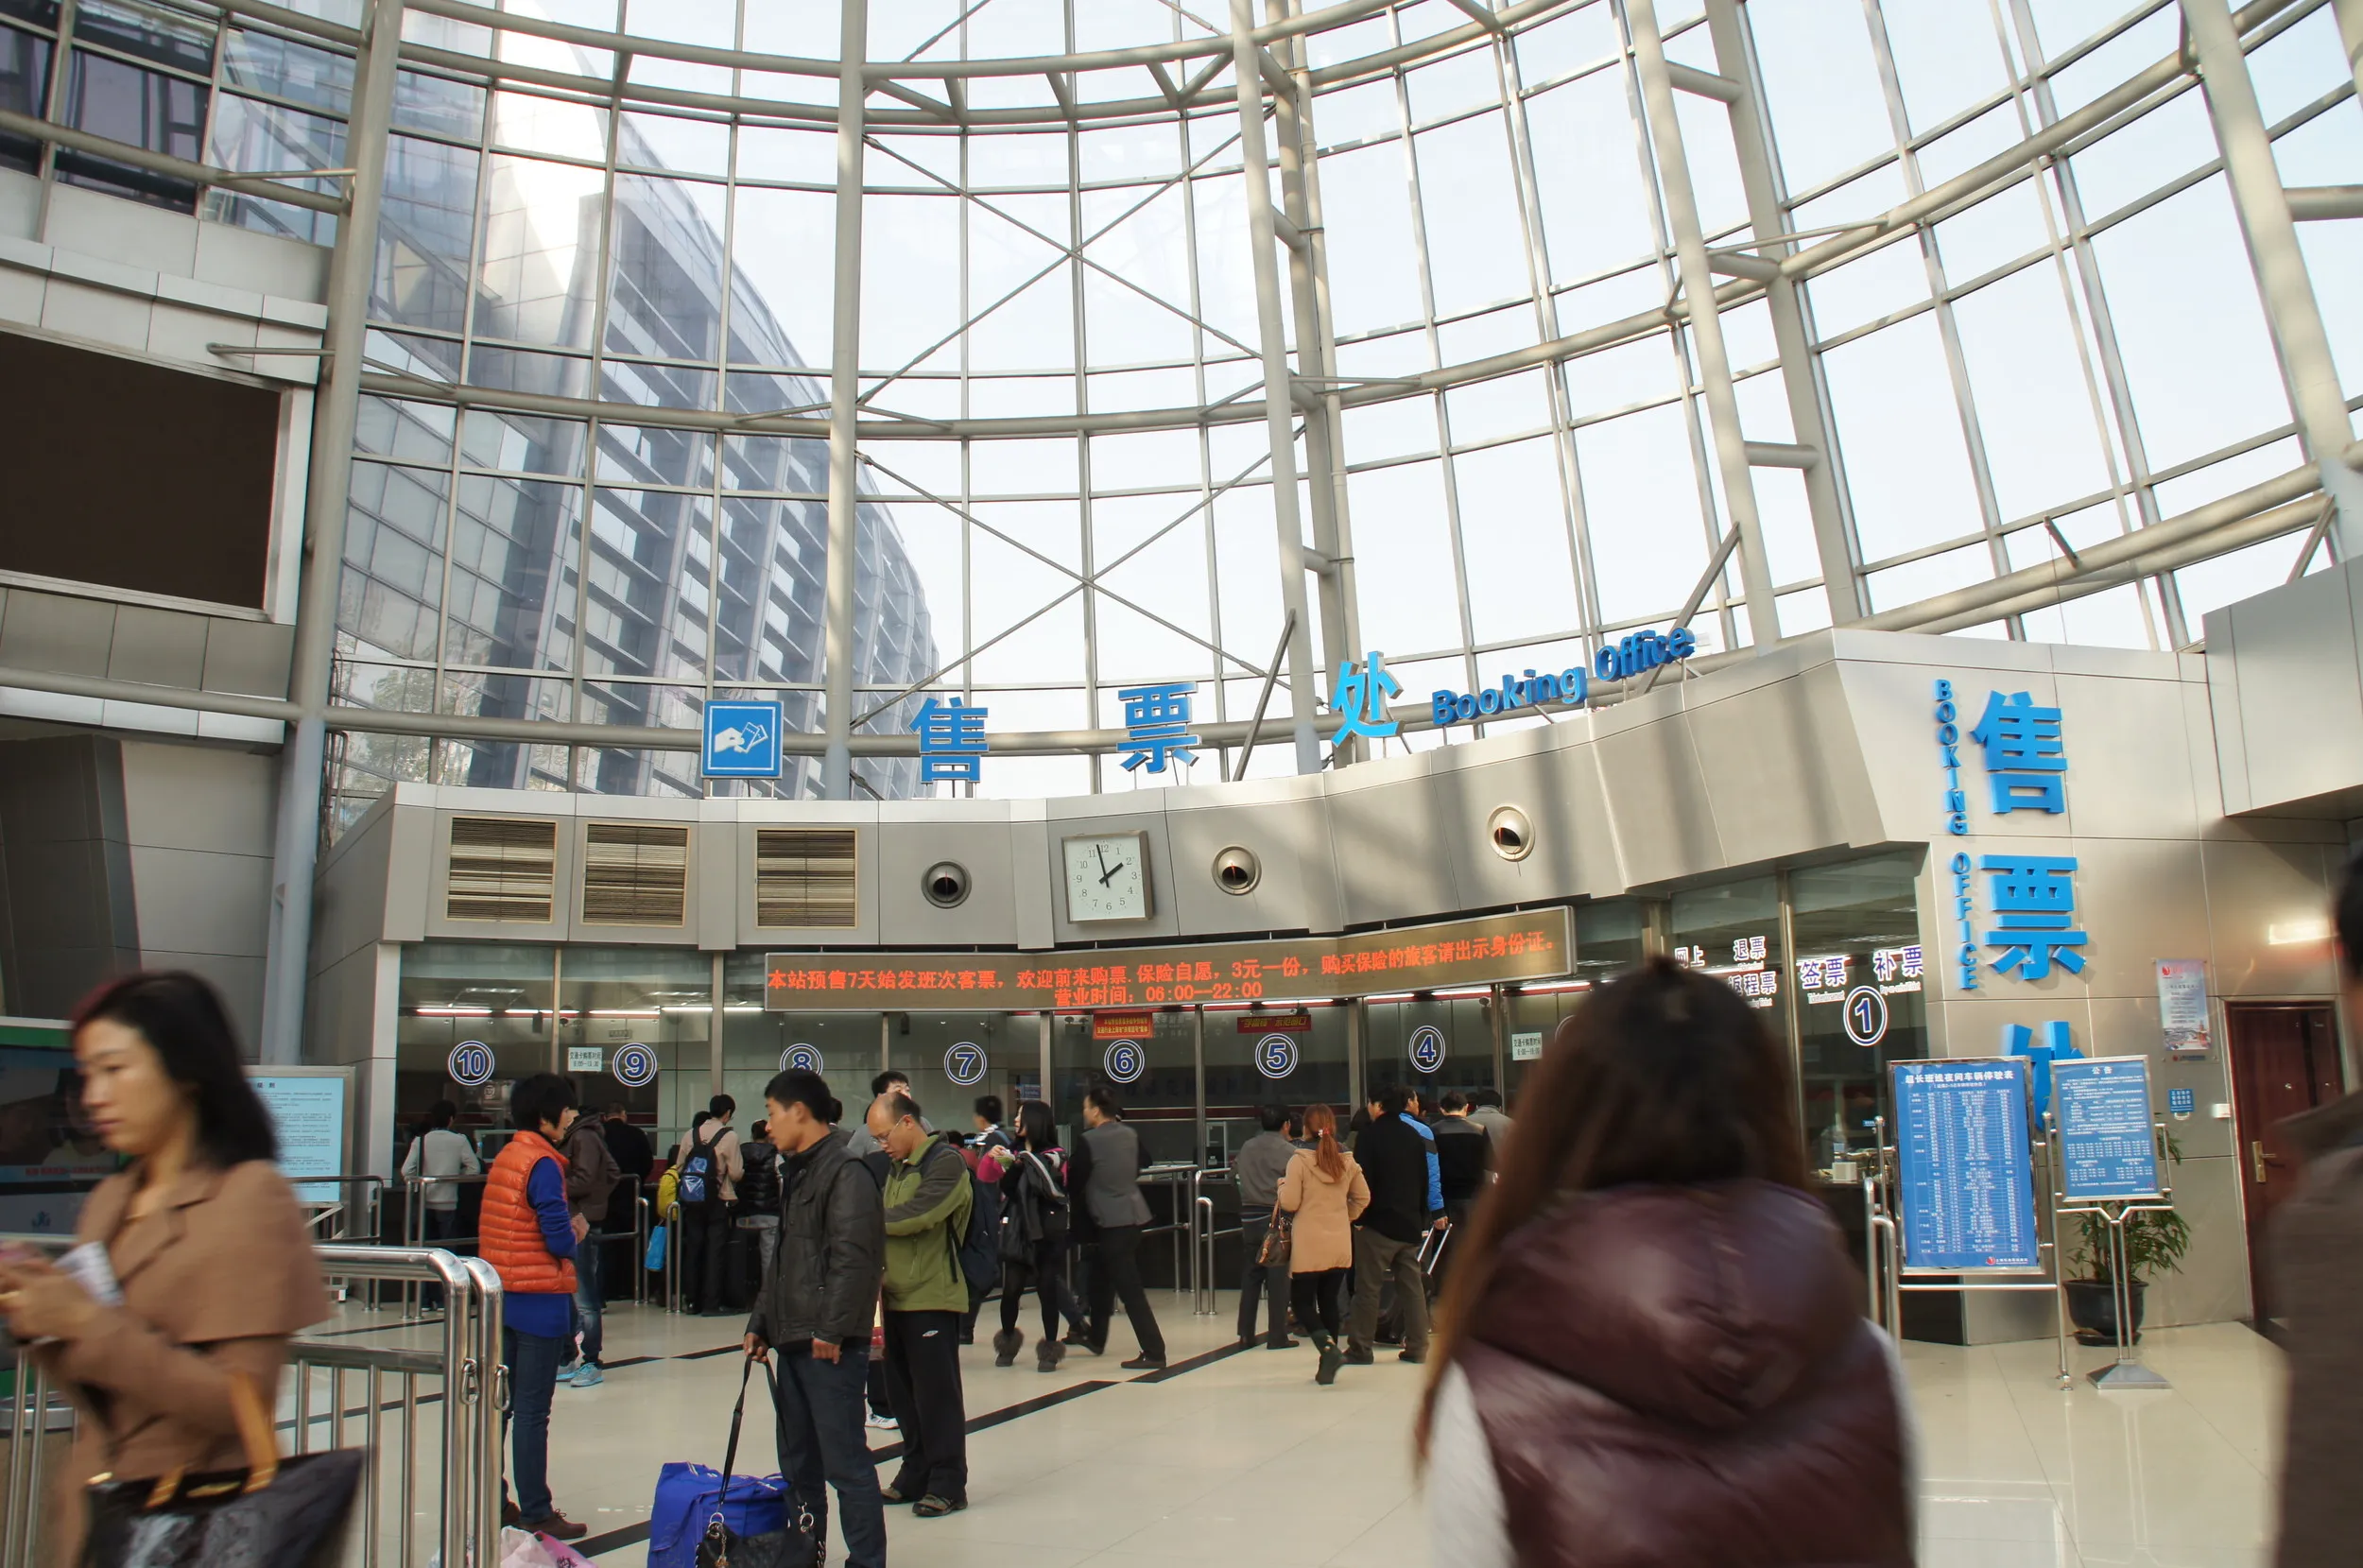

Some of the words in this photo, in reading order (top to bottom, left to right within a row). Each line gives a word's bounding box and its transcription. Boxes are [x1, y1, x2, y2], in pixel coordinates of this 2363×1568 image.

[1432, 667, 1588, 726] Booking
[1595, 627, 1697, 681] Office
[1934, 679, 1968, 835] BOOKING
[1079, 860, 1088, 869] 10
[1126, 857, 1132, 866] 2
[1131, 871, 1137, 880] 3
[1081, 888, 1088, 897] 8
[1119, 897, 1126, 906] 5
[1127, 887, 1133, 895] 4
[1106, 902, 1113, 910] 6
[1950, 852, 1979, 990] OFFICE
[1733, 936, 1766, 961] 退票
[1800, 956, 1847, 990] 签票
[1873, 944, 1923, 982] 补票
[1854, 997, 1872, 1033] 1
[791, 1051, 813, 1070] 8
[1113, 1047, 1134, 1073] 6
[1267, 1042, 1288, 1069] 5
[1417, 1034, 1437, 1062] 4
[457, 1049, 487, 1077] 10
[624, 1051, 647, 1077] 9
[956, 1052, 976, 1077] 7
